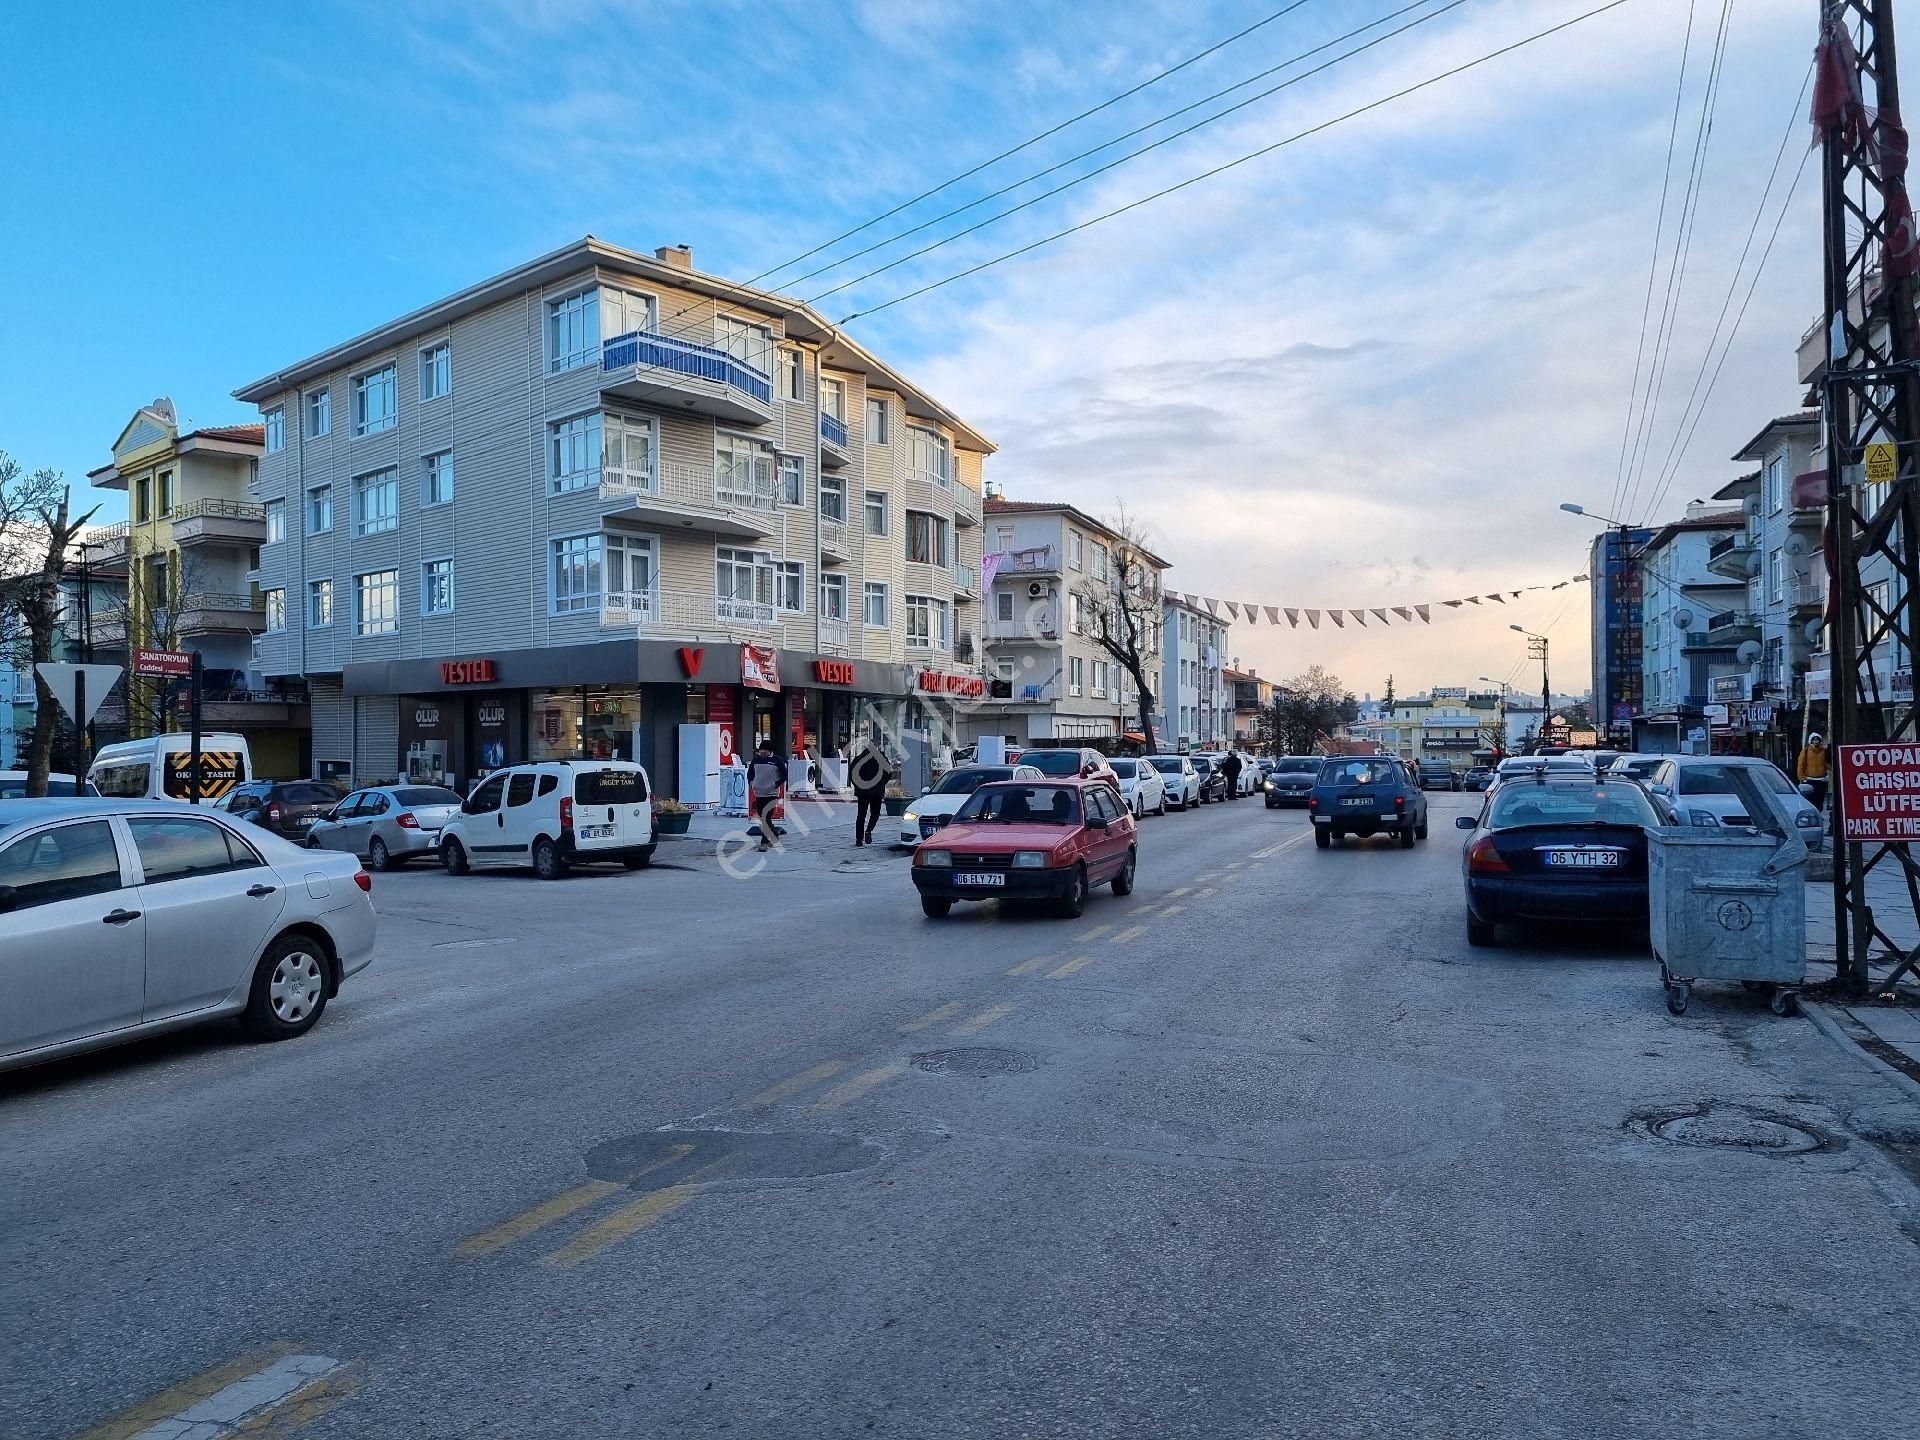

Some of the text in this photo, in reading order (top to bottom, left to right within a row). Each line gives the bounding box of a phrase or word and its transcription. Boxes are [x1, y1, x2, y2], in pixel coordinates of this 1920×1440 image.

[140, 652, 189, 663] SANATORYUM
[440, 659, 495, 683] VESTEL
[416, 709, 439, 722] OLUR
[479, 707, 505, 721] OLUR
[1863, 791, 1920, 811] LÜTFE
[1847, 818, 1920, 835] PARK ETME
[1552, 853, 1617, 864] 06 YTH 32
[958, 874, 1002, 885] 06 ELY 721
